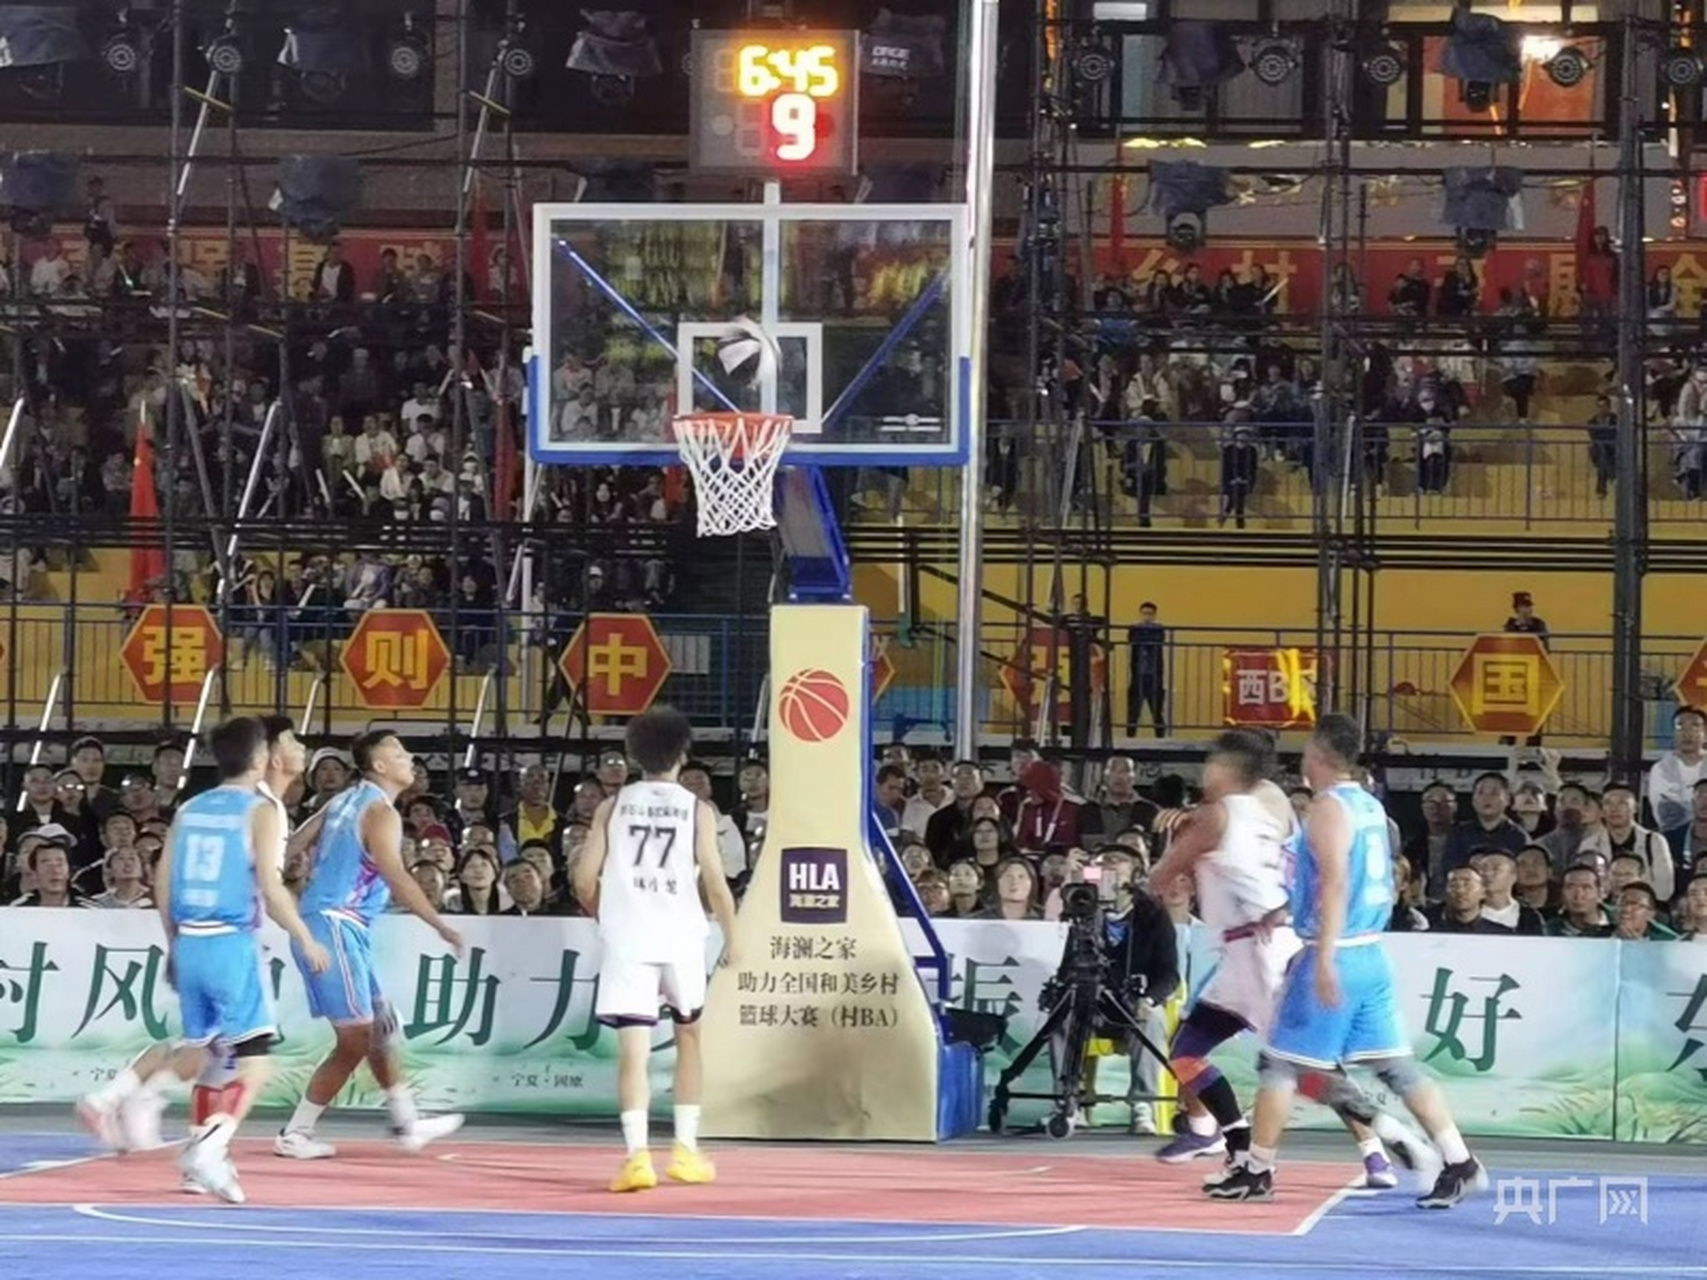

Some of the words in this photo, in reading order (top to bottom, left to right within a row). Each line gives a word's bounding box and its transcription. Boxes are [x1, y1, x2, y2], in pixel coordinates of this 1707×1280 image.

[772, 92, 816, 160] 9
[140, 625, 206, 685] 强
[365, 629, 428, 690] 则
[588, 634, 648, 696] 中
[1473, 653, 1540, 716] 国
[184, 833, 225, 882] 13
[628, 824, 677, 868] 77
[789, 863, 840, 890] HLA
[770, 936, 857, 960] 海澜之家
[737, 971, 899, 995] 助力全国和美乡村
[1420, 967, 1523, 1072] 好
